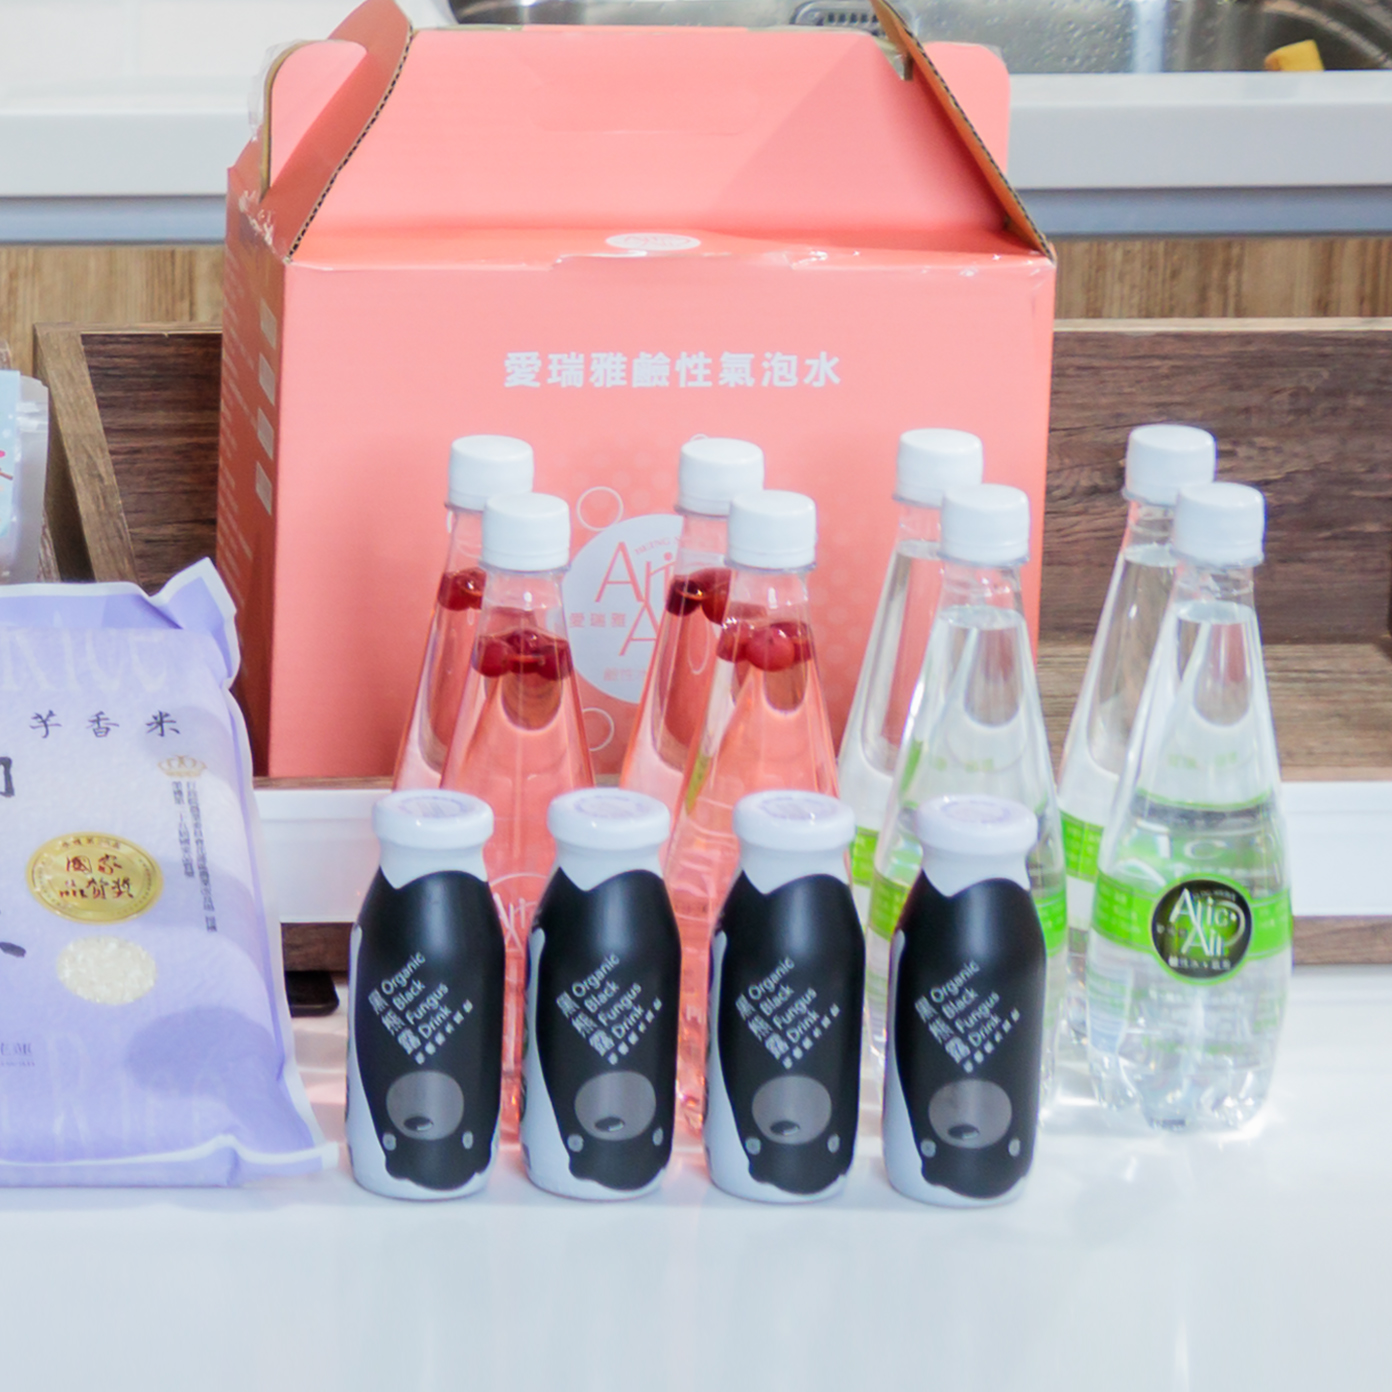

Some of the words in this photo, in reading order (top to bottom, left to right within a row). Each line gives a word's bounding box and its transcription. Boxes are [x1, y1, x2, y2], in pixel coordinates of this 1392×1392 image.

[504, 351, 842, 388] 愛瑞雅鹼性氣泡水
[29, 709, 181, 739] 芋香米
[381, 952, 426, 995] Organic
[571, 953, 620, 997] Organic
[748, 956, 795, 1000] Organic
[930, 960, 980, 1003] Organic
[392, 979, 425, 1011] Black
[405, 982, 449, 1025] Fungus
[584, 980, 620, 1013] Black
[597, 982, 642, 1026] Fungus
[759, 984, 795, 1016] Black
[772, 987, 817, 1030] Fungus
[942, 988, 979, 1019] Black
[954, 991, 1000, 1034] Fungus
[418, 1005, 452, 1039] Drink
[611, 1004, 644, 1039] Drink
[786, 1009, 820, 1043] Drink
[968, 1013, 1002, 1047] Drink
